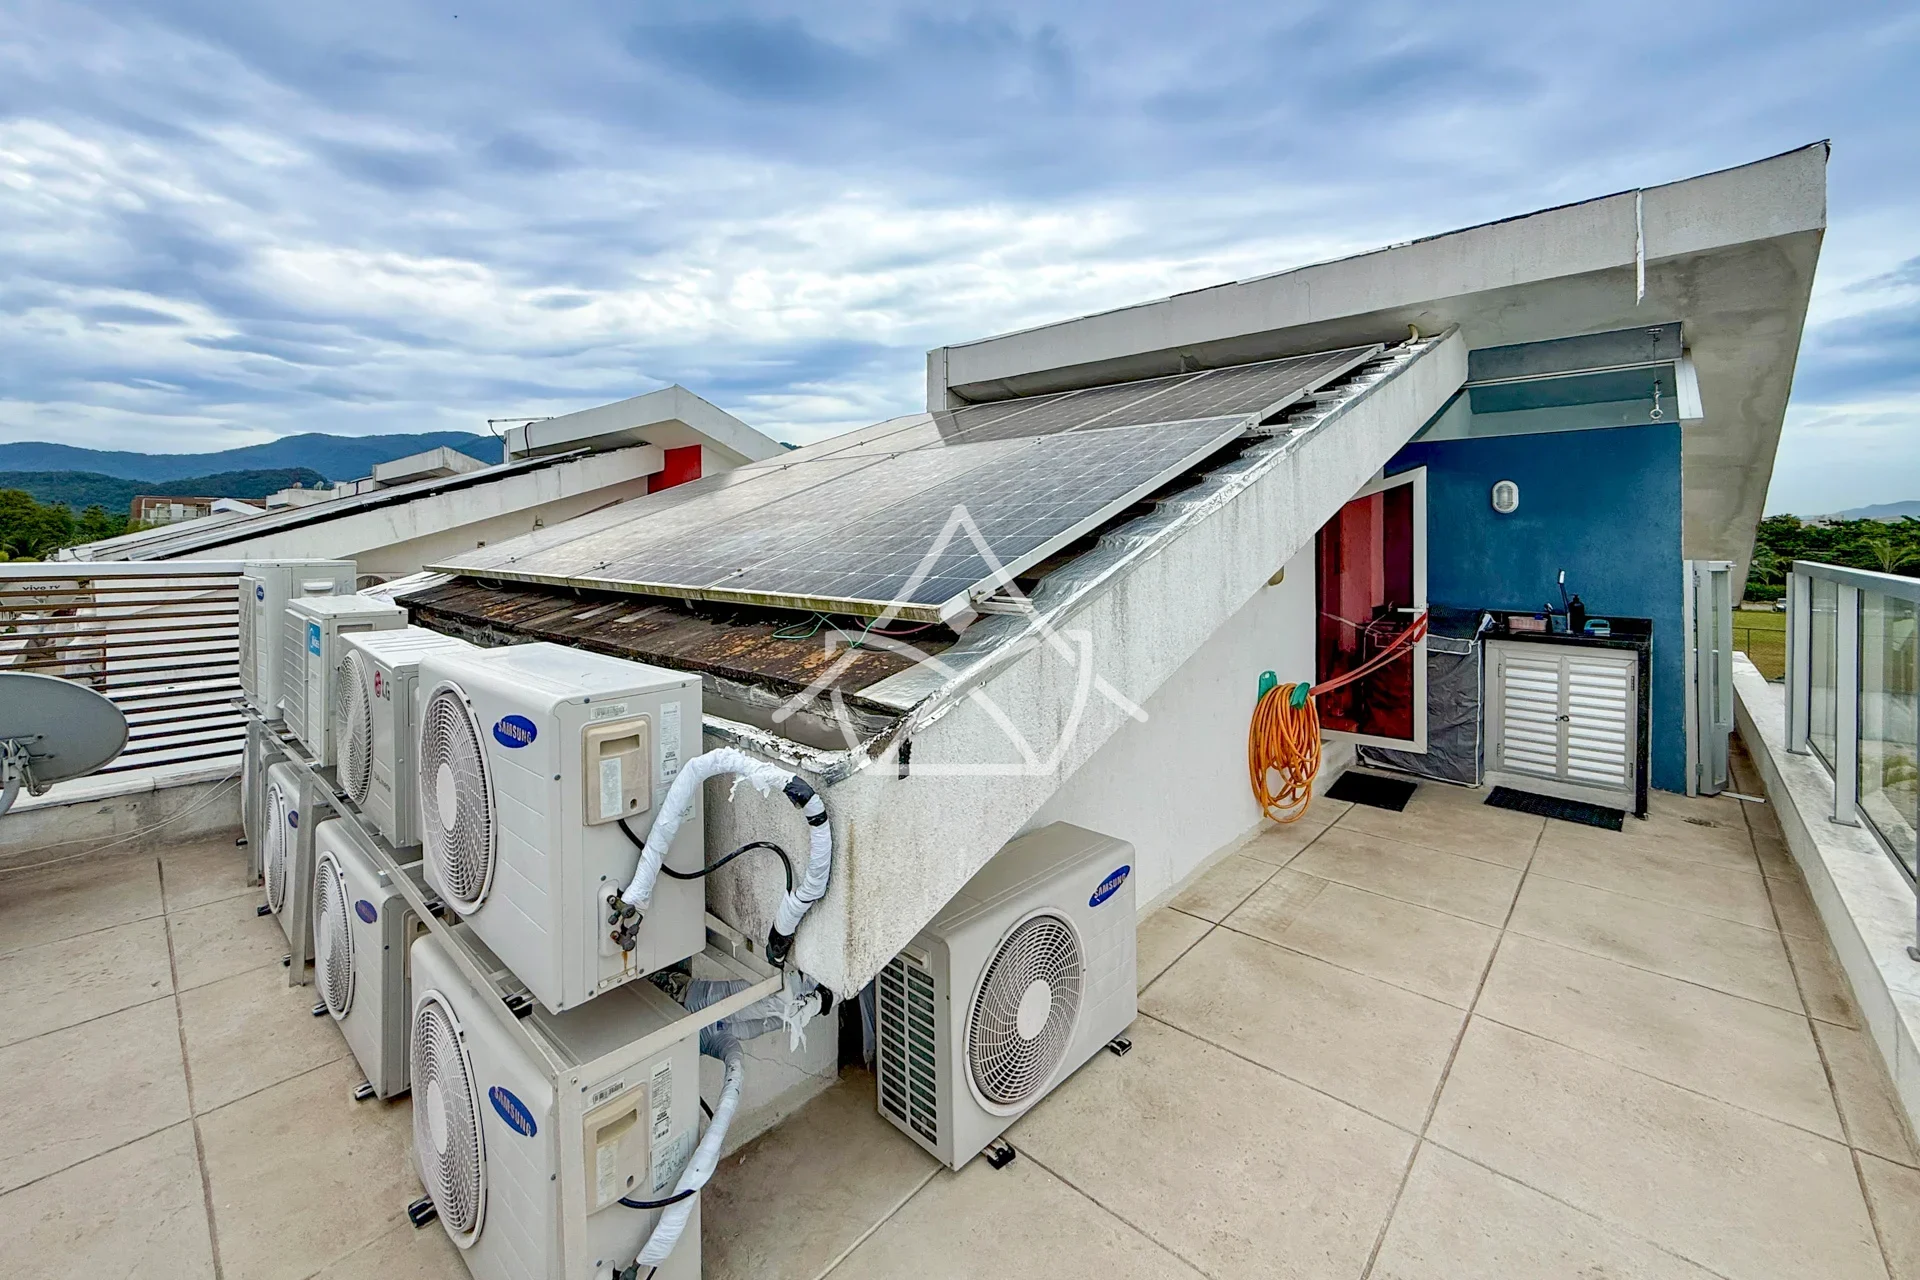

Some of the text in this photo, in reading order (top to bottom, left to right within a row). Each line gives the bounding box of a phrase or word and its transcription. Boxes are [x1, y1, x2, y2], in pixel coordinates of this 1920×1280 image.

[381, 677, 391, 701] LG
[497, 720, 532, 744] SAMSUNG
[1093, 872, 1126, 899] SAMSUNG
[494, 1087, 531, 1136] SAMSUNG
